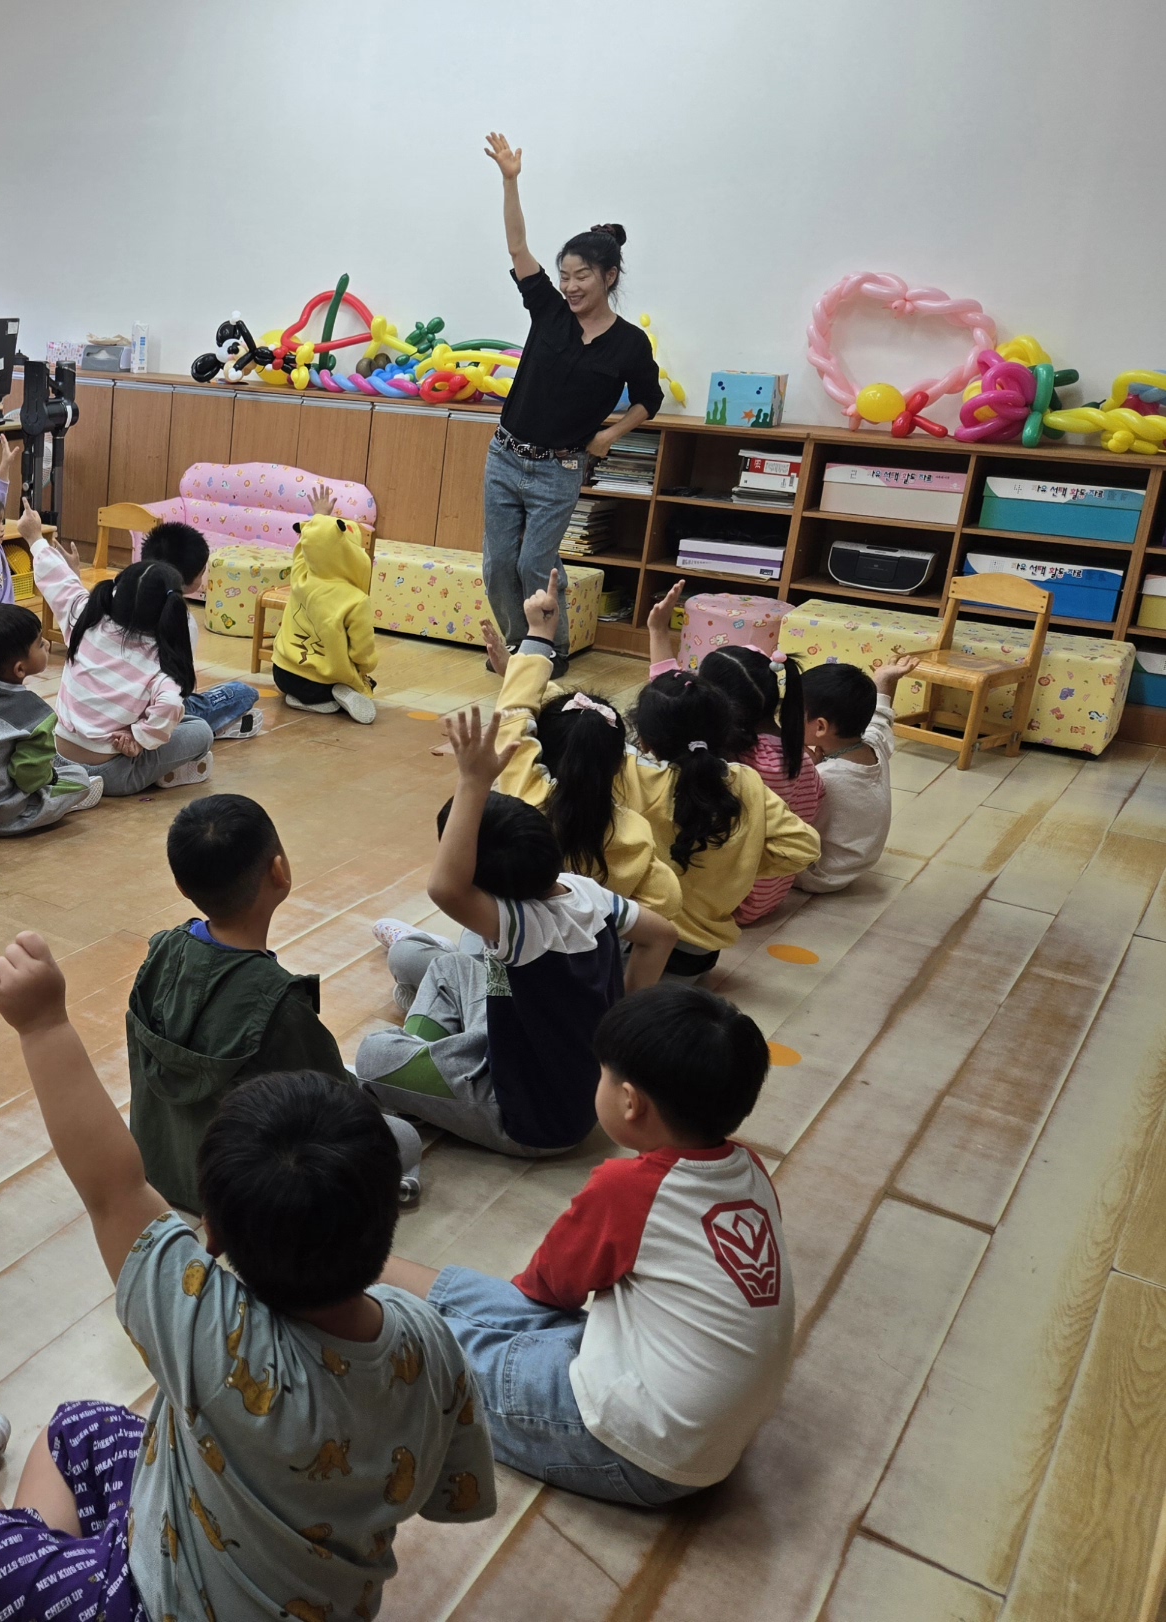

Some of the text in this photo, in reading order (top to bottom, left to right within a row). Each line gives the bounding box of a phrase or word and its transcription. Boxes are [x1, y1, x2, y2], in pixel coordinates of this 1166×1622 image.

[1050, 485, 1067, 498] 선택
[1069, 488, 1086, 500] 활동
[1029, 564, 1046, 577] 선택
[1049, 566, 1064, 579] 활동
[1067, 568, 1083, 578] 자료
[94, 1457, 113, 1476] GREA
[36, 1573, 58, 1592] NEW
[13, 1594, 25, 1610] UP
[44, 1588, 84, 1621] CHEER UP
